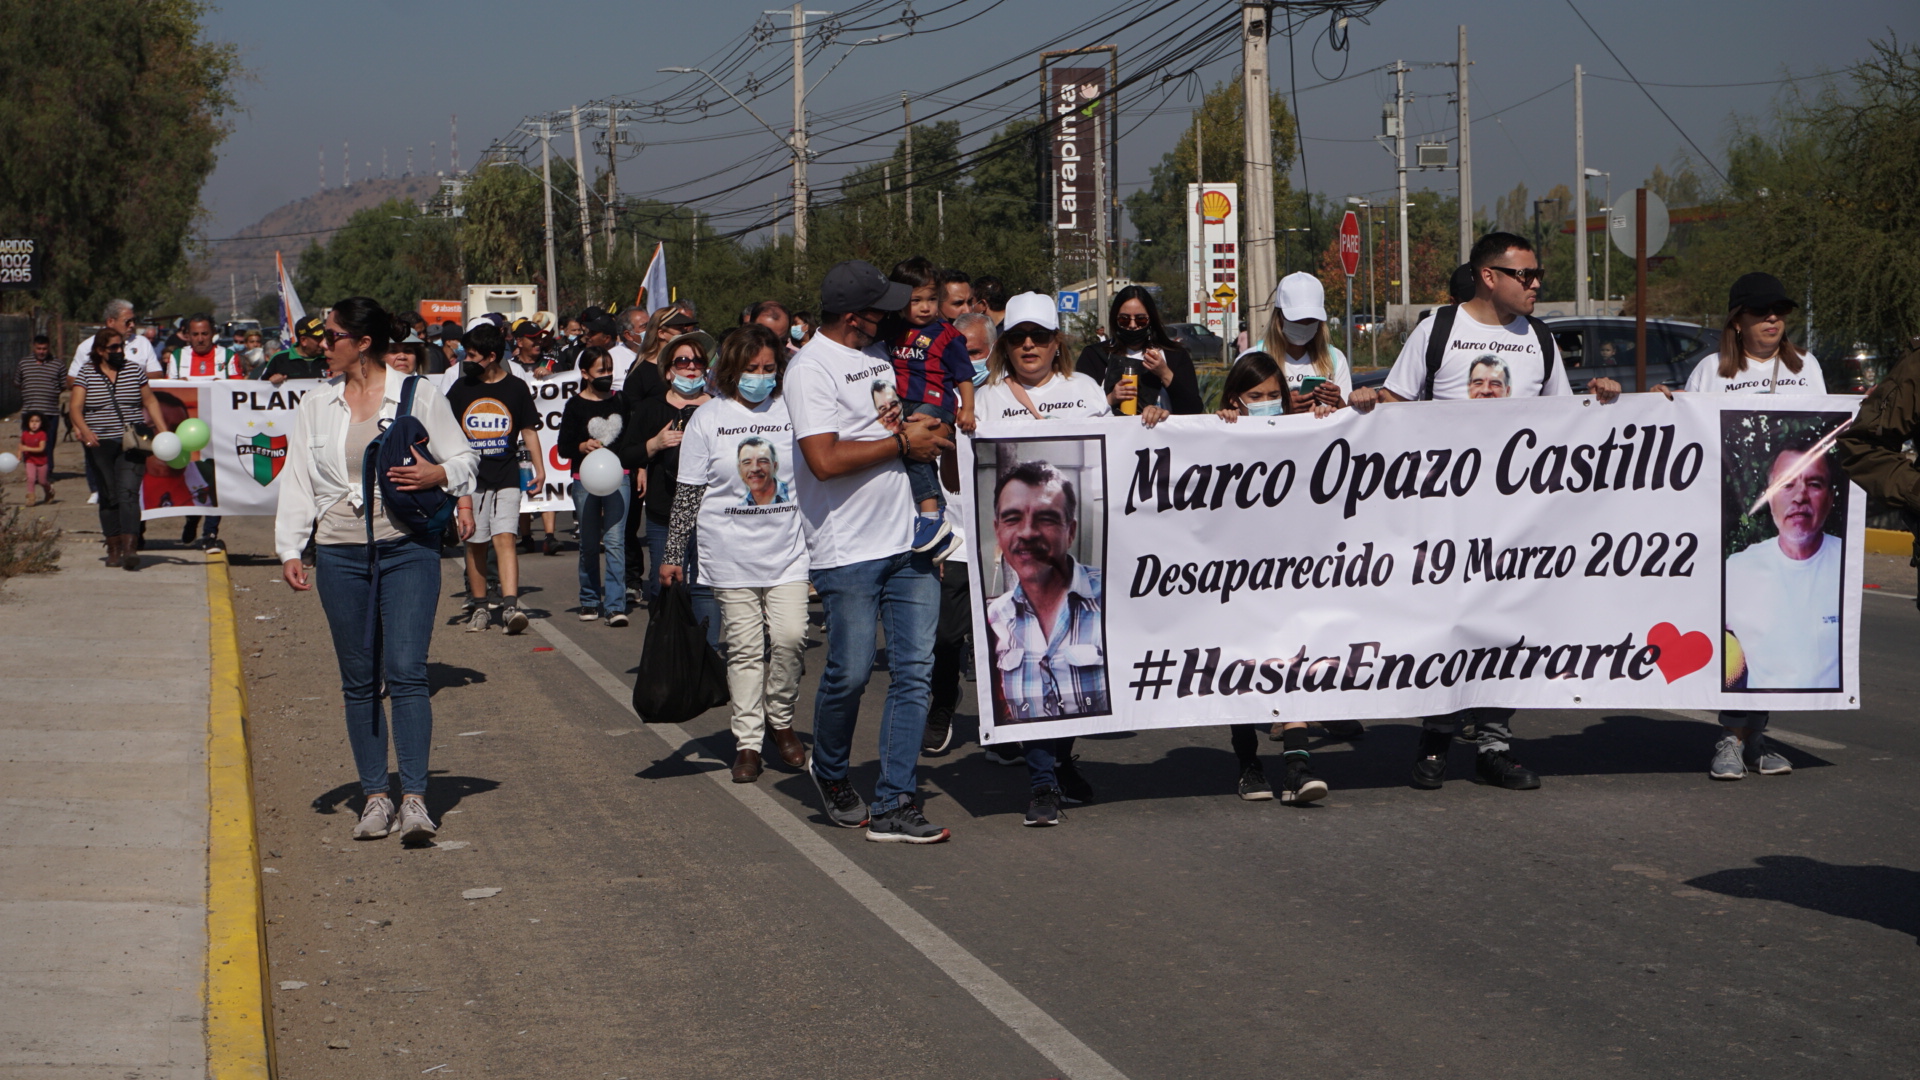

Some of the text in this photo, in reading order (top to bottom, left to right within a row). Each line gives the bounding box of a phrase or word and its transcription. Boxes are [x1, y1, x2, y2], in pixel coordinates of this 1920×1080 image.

[1058, 83, 1081, 230] Larapinta
[1342, 234, 1359, 253] PARE
[0, 268, 32, 283] 2195
[1451, 340, 1536, 354] Marco Opazo C.
[845, 369, 870, 384] Marco
[1725, 377, 1808, 392] Marco Oazo C.
[232, 390, 310, 410] PLAN
[1039, 401, 1074, 412] Opazo
[1077, 399, 1087, 409] C.
[467, 416, 508, 428] Gulf
[716, 426, 748, 437] Marco
[750, 422, 782, 434] Opazo
[487, 439, 497, 447] OIL
[239, 447, 285, 457] PALESTINO
[1125, 423, 1704, 520] Marco Opazo Castillo
[724, 504, 798, 516] #HastaEncontrarte
[1129, 531, 1698, 604] Desaparecido 19 Marzo 2022
[1128, 632, 1662, 701] #HastaEncontrarte
